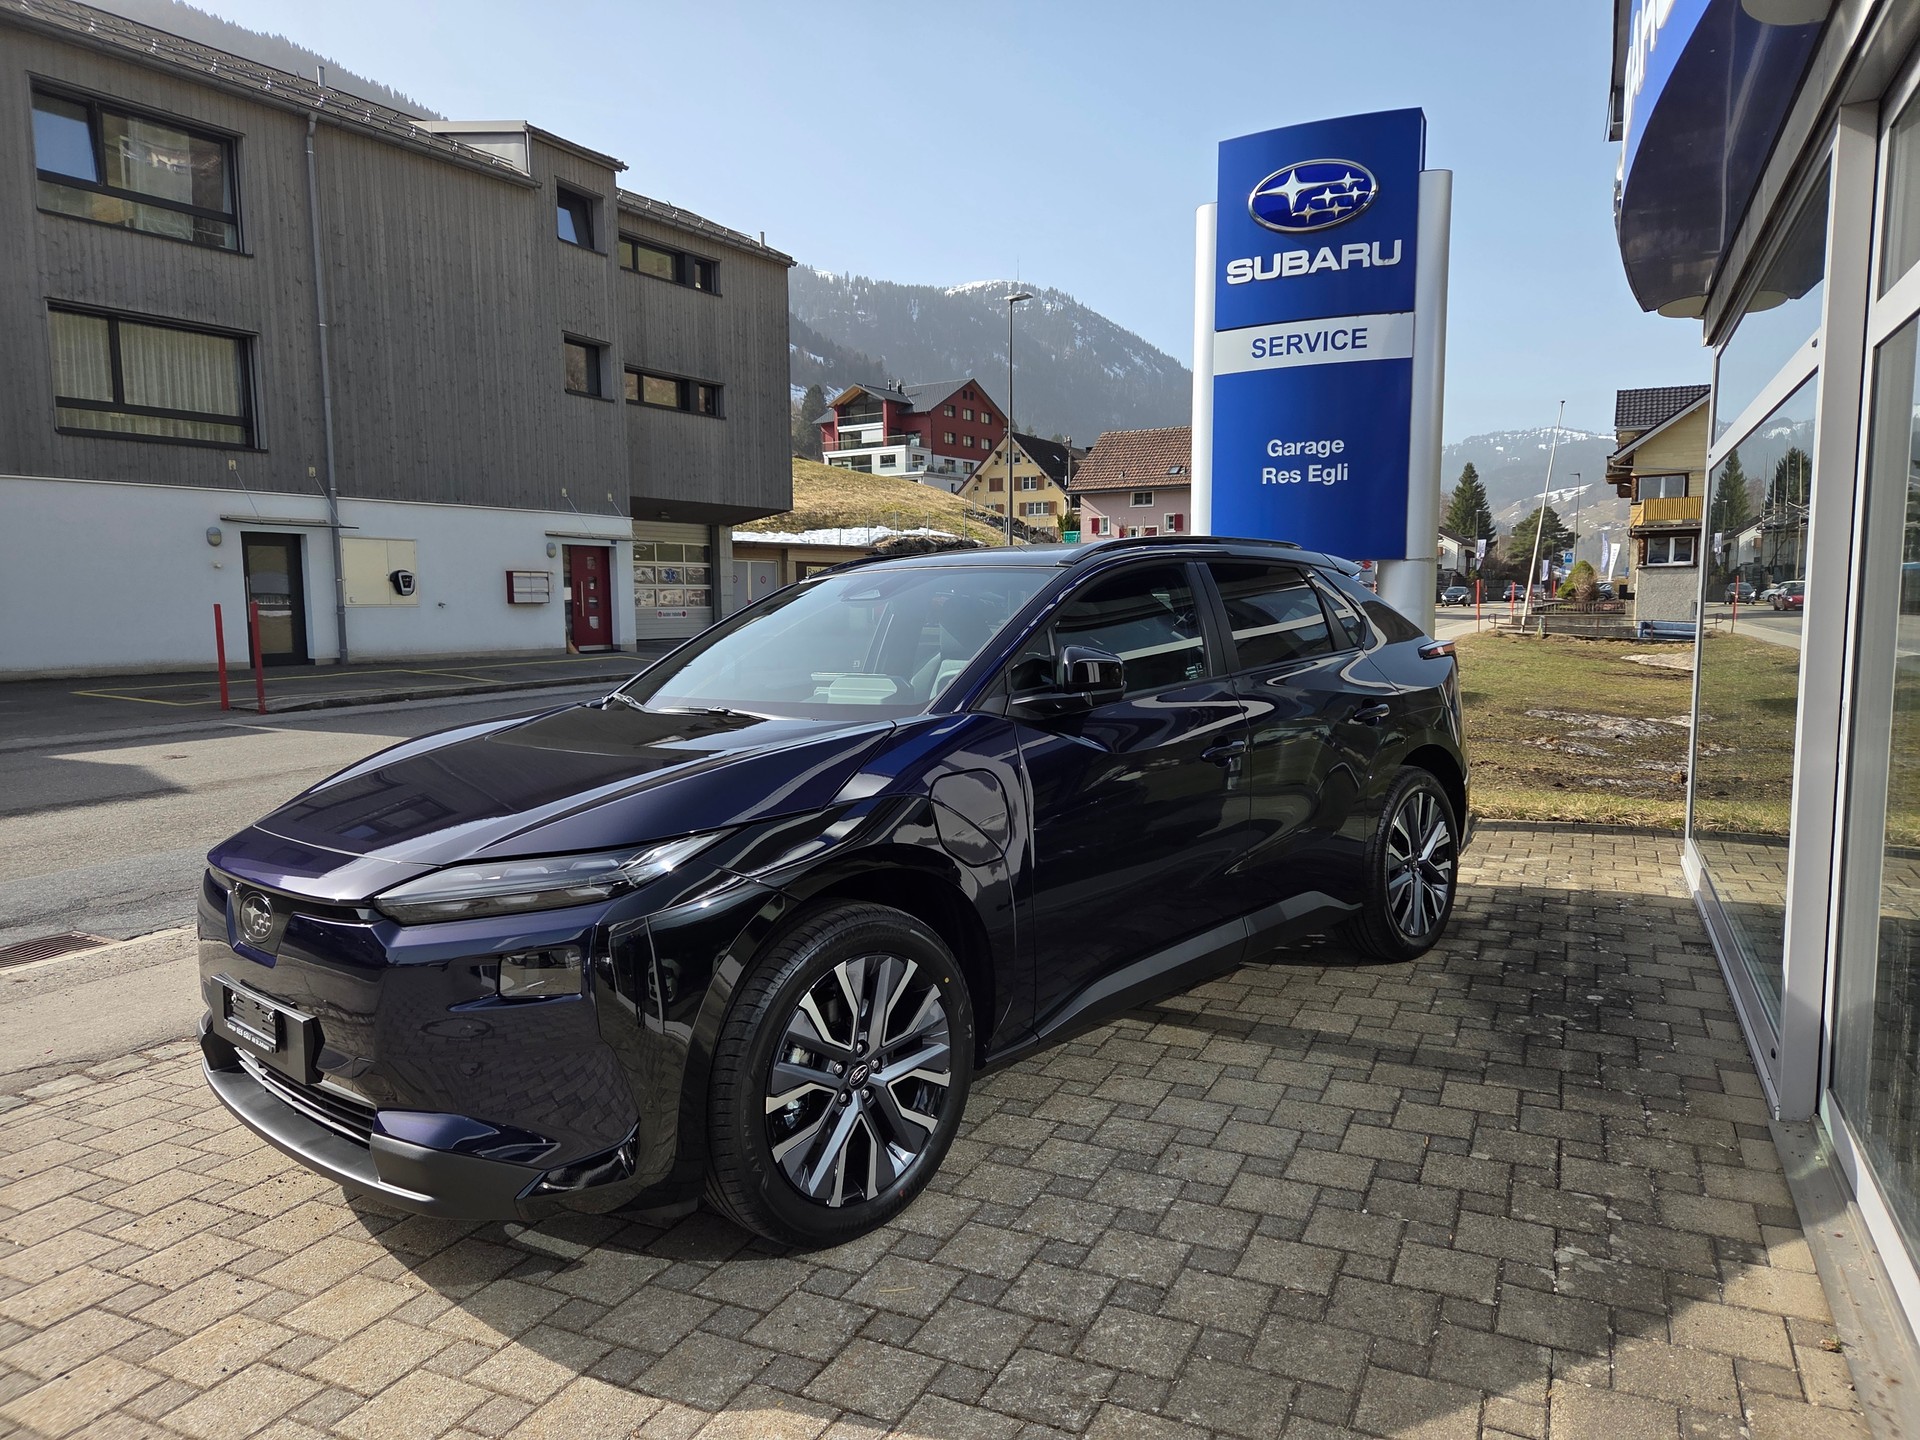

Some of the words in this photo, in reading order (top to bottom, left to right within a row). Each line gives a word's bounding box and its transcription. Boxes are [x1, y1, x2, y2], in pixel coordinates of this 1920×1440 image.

[1226, 239, 1403, 285] SUBARU
[1251, 327, 1368, 359] SERVICE
[1266, 439, 1345, 458] Garage
[1262, 467, 1301, 485] Res
[1308, 463, 1349, 486] Egli
